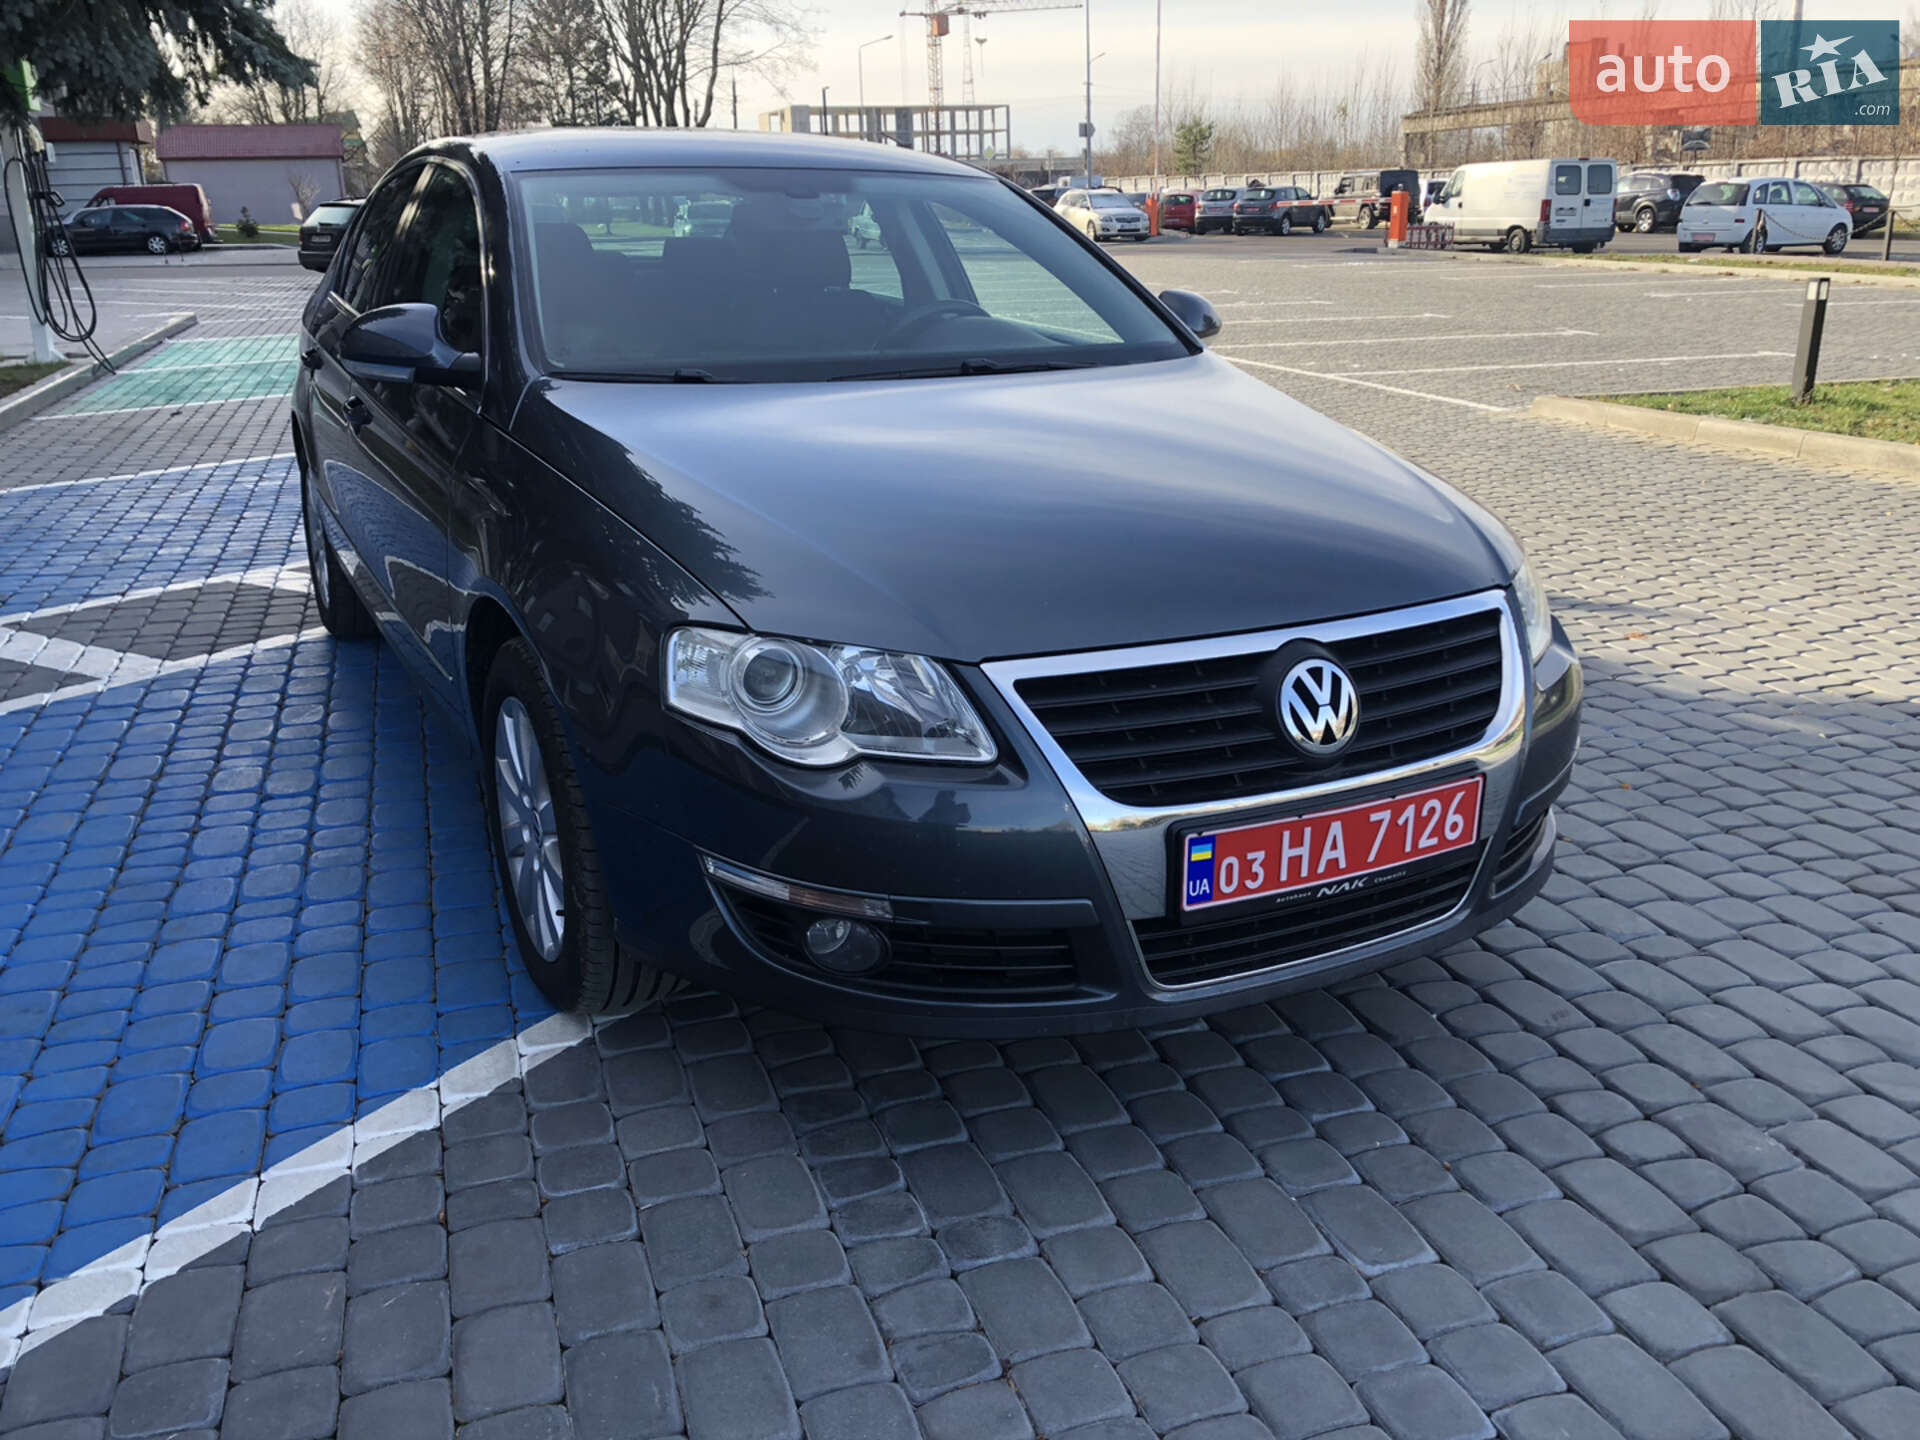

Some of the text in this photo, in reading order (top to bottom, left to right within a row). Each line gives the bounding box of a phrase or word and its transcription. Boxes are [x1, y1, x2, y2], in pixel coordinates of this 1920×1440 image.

[1218, 791, 1466, 894] 03 HA 7126
[1188, 878, 1211, 897] UA
[1316, 876, 1368, 898] NAK
